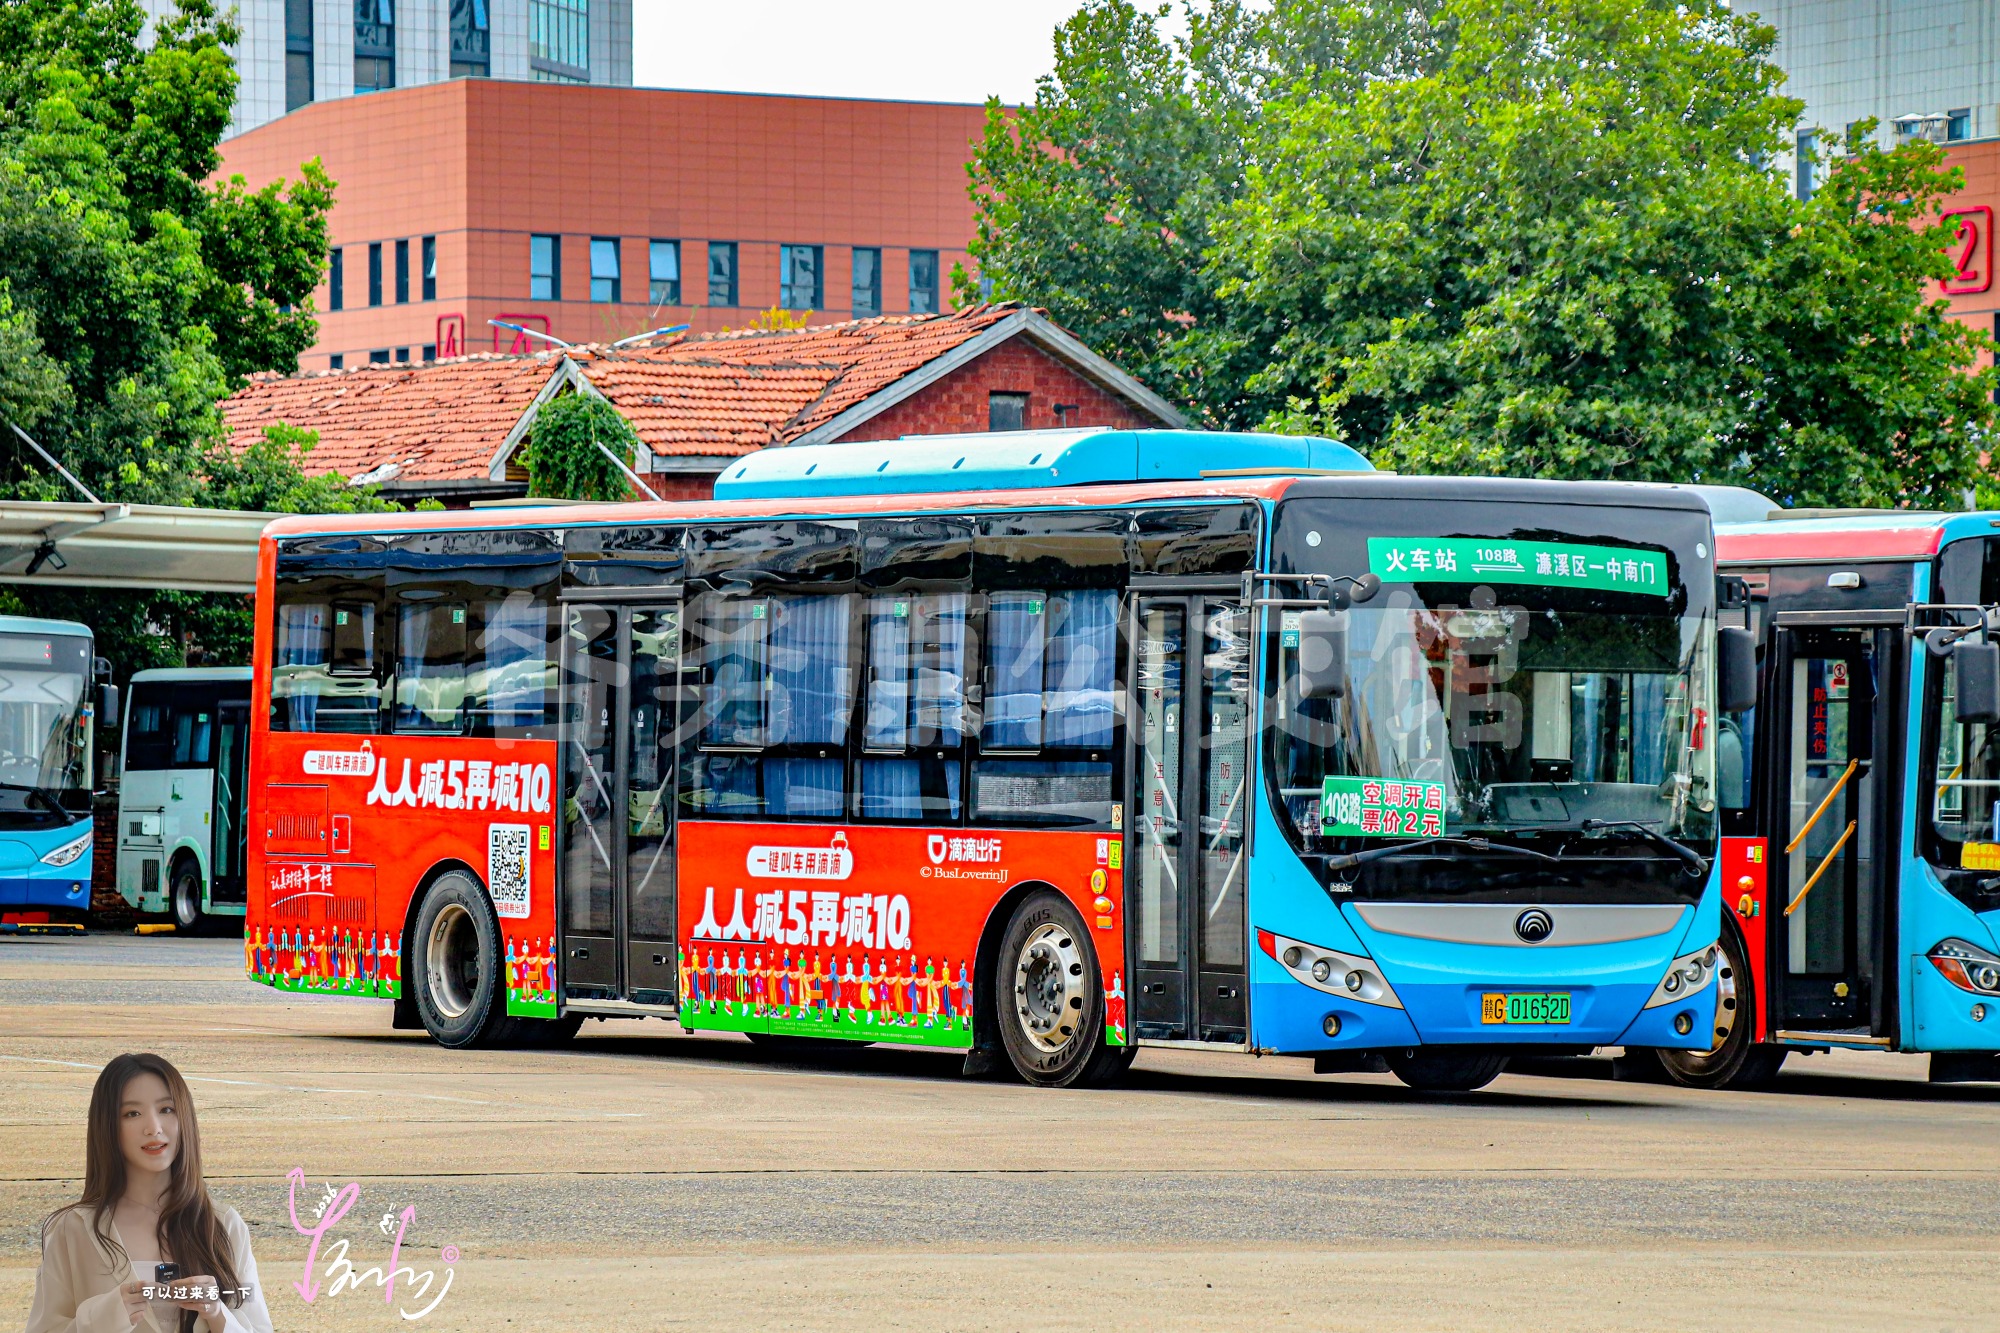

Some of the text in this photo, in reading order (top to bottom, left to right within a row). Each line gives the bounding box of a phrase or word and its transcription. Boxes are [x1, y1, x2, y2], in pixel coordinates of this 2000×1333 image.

[1386, 547, 1656, 585] 火车站 108路 濂溪区一中南门
[1812, 687, 1828, 754] 防止夹伤
[309, 754, 368, 773] 一键叫车用滴滴
[1325, 791, 1361, 827] 108路
[1362, 781, 1442, 811] 空调开启
[1152, 762, 1165, 862] 注意开门
[1218, 762, 1232, 862] 防止夹伤
[1361, 808, 1442, 837] 票价2元
[756, 850, 842, 876] 一键叫车用滴滴
[948, 837, 1002, 862] 滴滴出行
[270, 863, 333, 892] 认真对待每一程
[1484, 998, 1569, 1020] 赣G 01652D
